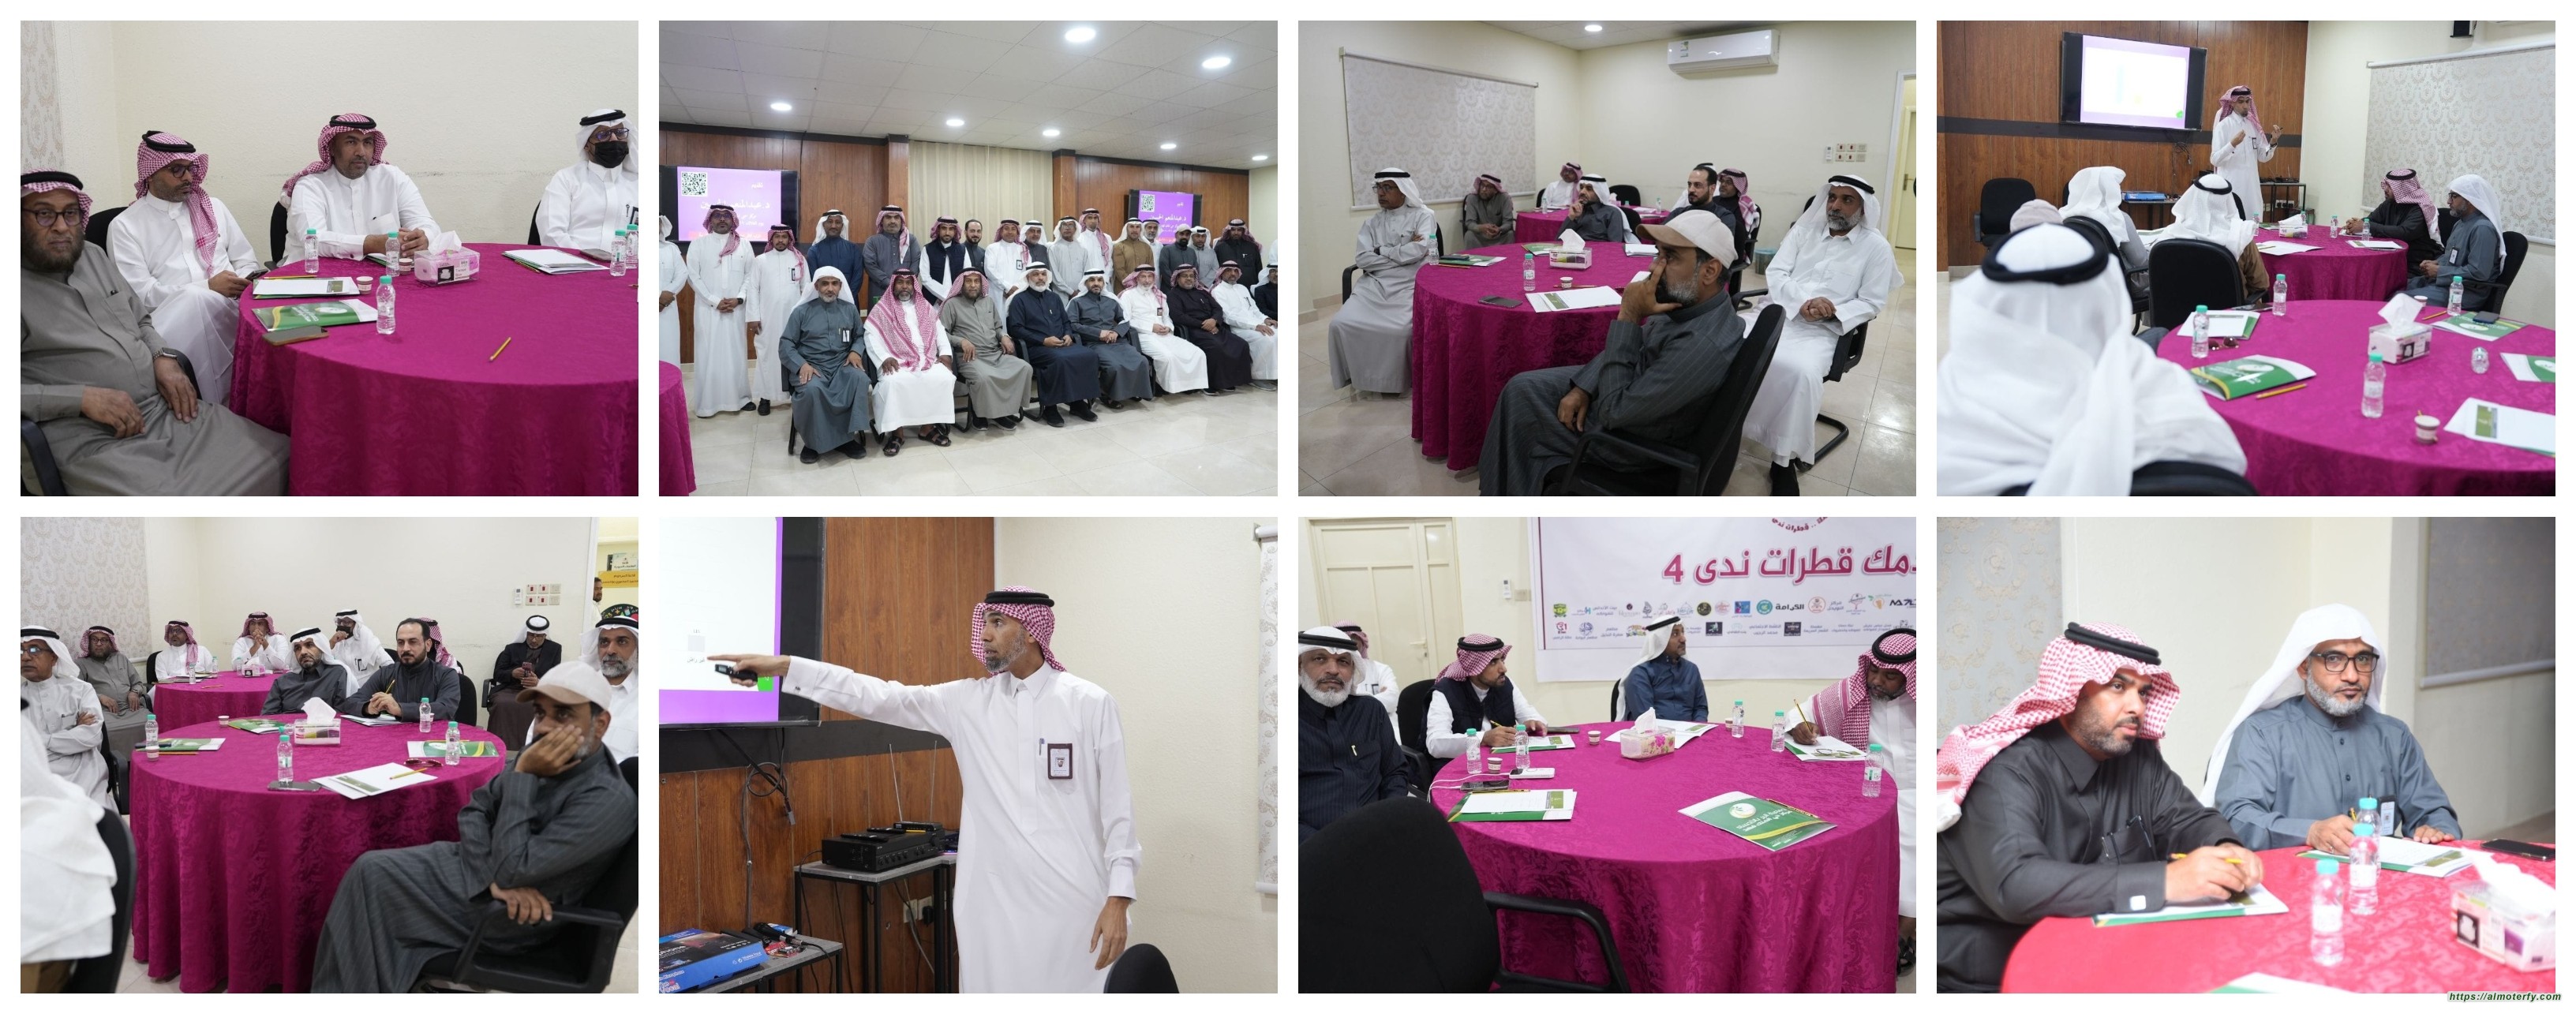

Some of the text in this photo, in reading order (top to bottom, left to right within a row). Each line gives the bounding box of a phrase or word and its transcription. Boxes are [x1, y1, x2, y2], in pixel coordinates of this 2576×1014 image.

[1663, 553, 1684, 584] 4
[1694, 550, 1750, 584] ندى
[1759, 547, 1853, 584] قطرات
